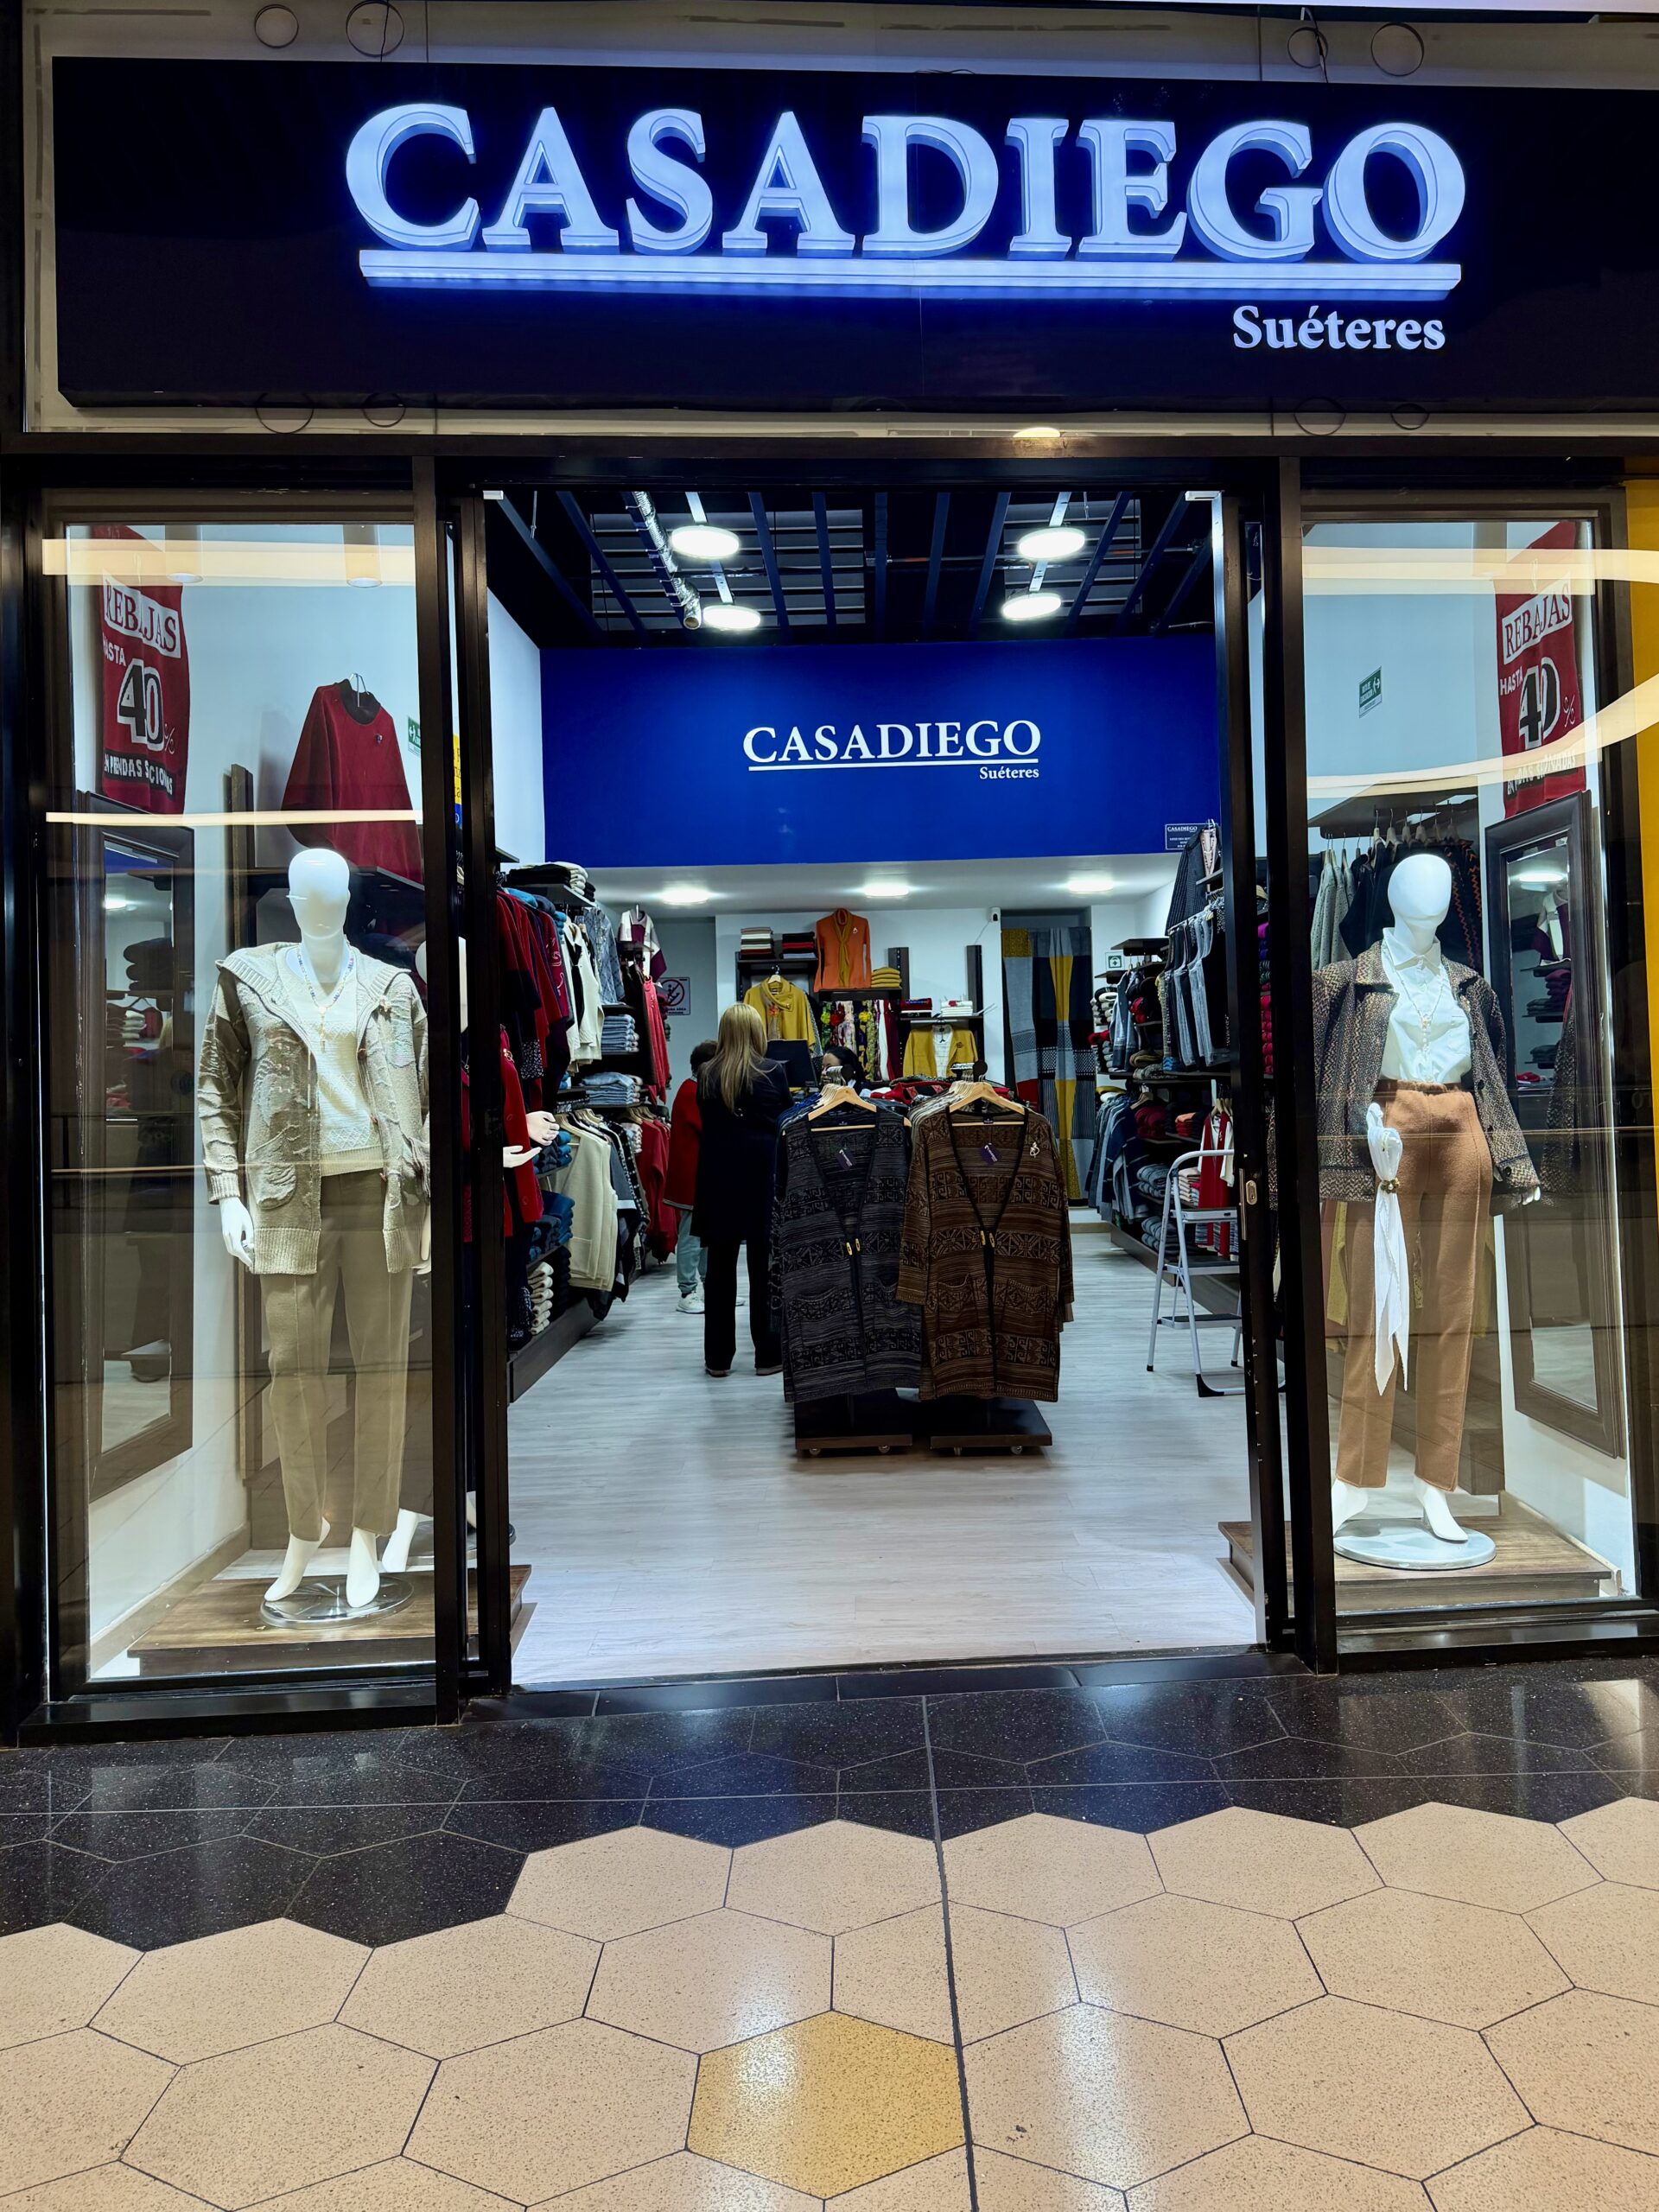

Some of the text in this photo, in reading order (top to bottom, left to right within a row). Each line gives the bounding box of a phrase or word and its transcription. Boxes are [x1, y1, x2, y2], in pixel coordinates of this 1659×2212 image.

[346, 102, 1466, 264] CASADIEGO
[1232, 305, 1446, 350] Suéteres
[1504, 583, 1570, 658] REBAJAS
[1499, 665, 1523, 696] HASTA
[743, 720, 1041, 763] CASADIEGO
[979, 766, 1039, 780] Suéteres
